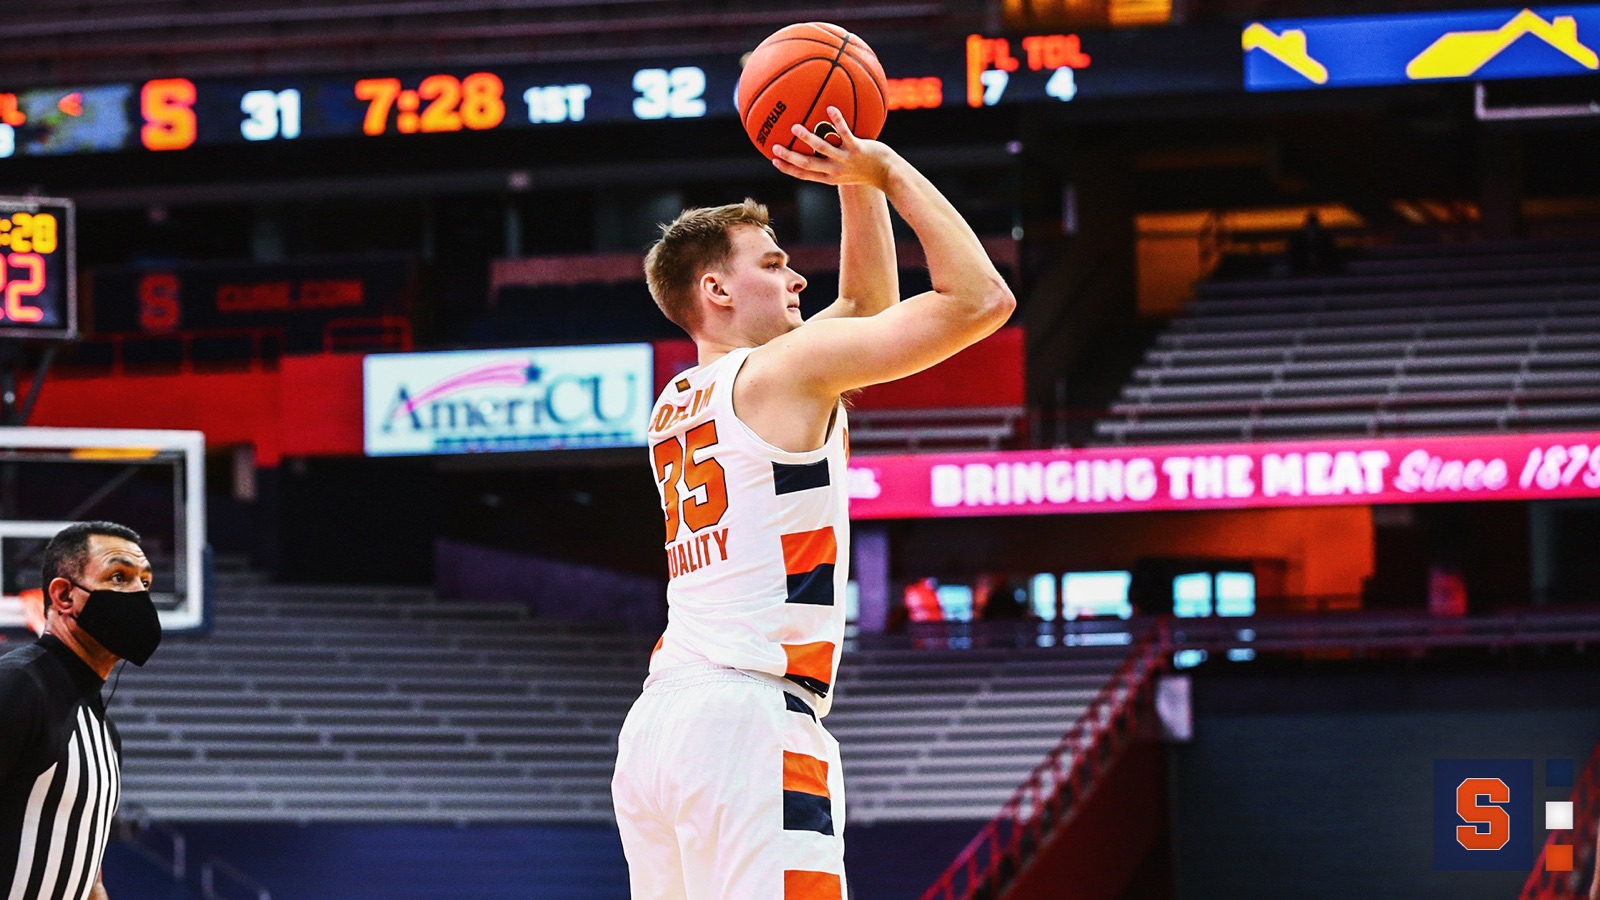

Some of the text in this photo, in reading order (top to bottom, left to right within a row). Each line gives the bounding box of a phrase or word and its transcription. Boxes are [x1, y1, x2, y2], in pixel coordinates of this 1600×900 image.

[354, 72, 505, 136] 7:28
[523, 84, 591, 123] 1ST
[632, 66, 706, 120] 32
[980, 66, 1077, 106] 7 4
[141, 78, 197, 151] S
[240, 88, 300, 141] 31
[381, 373, 638, 434] AmeriCU
[653, 419, 729, 546] 35
[931, 458, 1157, 507] BRINGING
[1162, 454, 1255, 500] THE
[1261, 450, 1390, 497] MEAT
[1393, 449, 1508, 493] Since
[667, 528, 729, 580] UALITY
